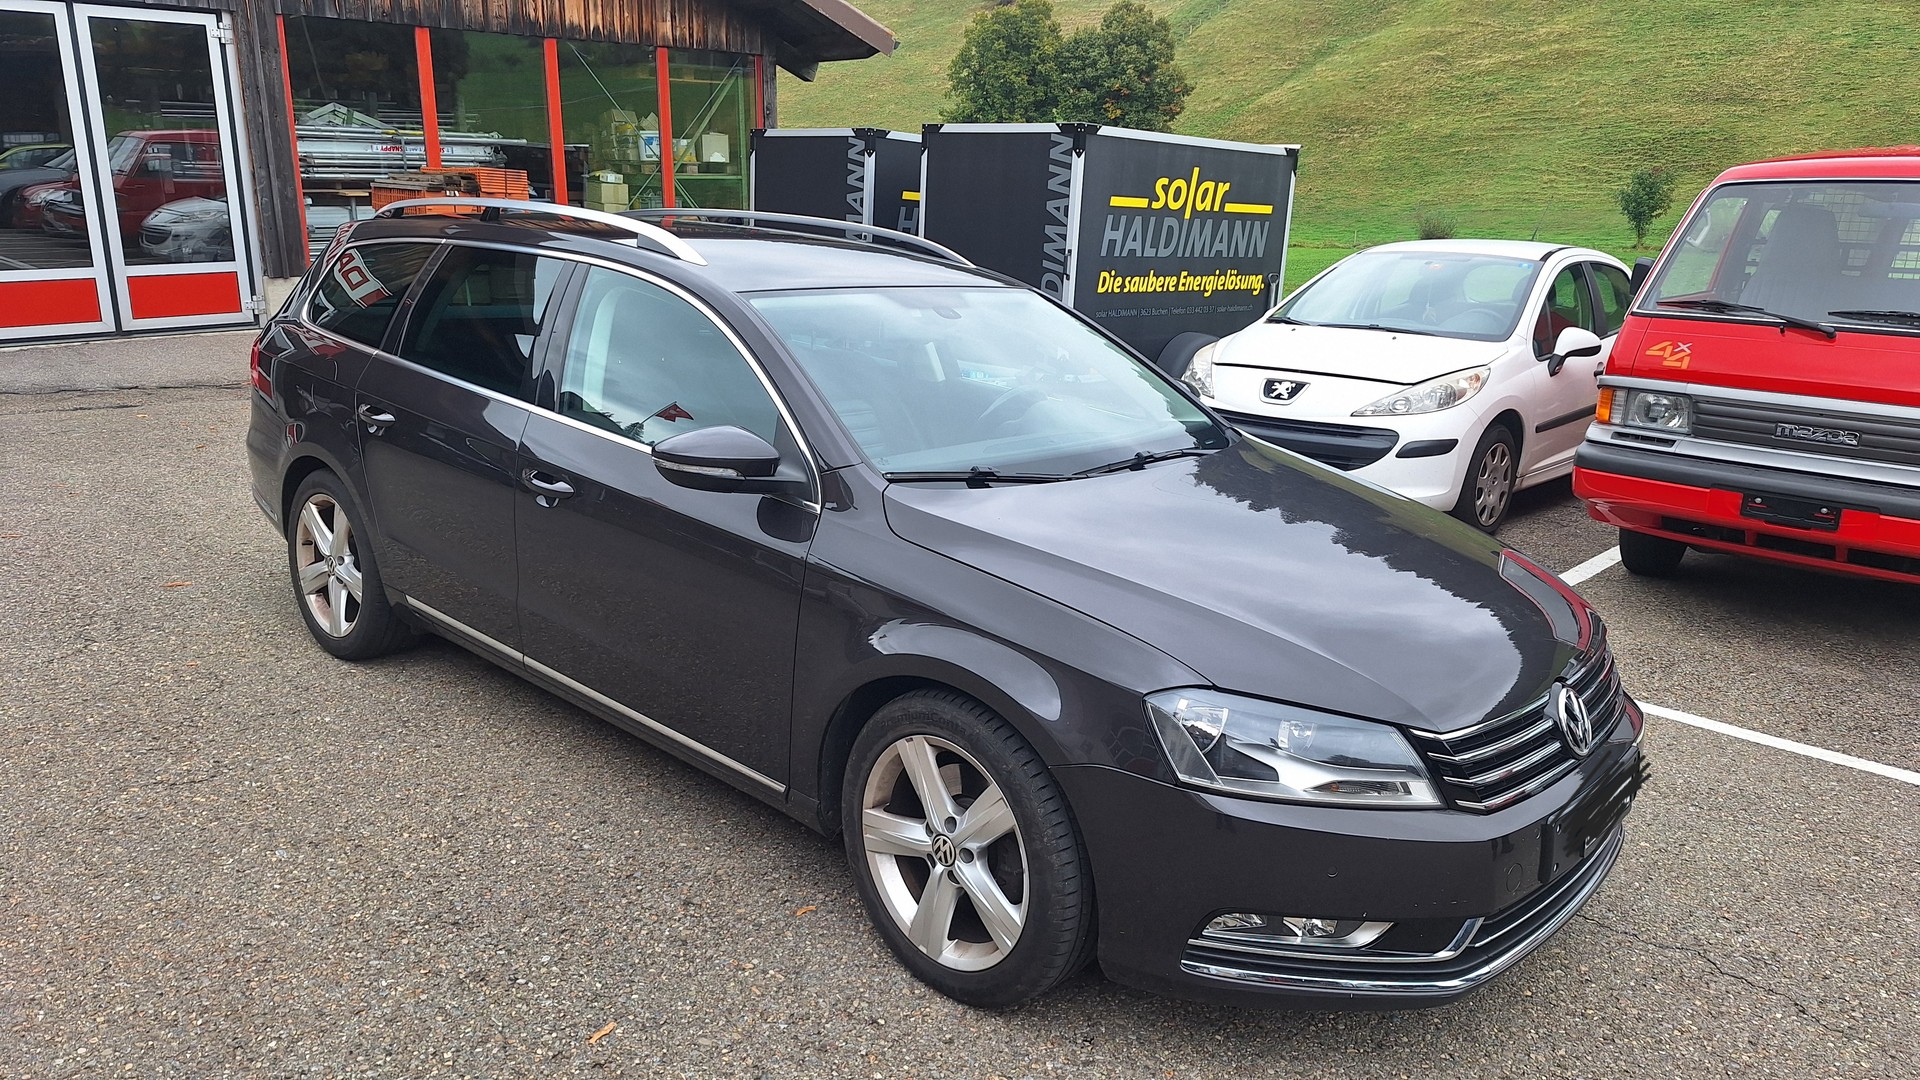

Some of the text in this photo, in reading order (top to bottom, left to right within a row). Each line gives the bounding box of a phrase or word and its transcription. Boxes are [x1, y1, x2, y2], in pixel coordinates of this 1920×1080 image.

[1151, 166, 1231, 219] solar
[1100, 213, 1270, 258] HALDIMANN
[1096, 269, 1265, 297] Die saubere Energielösung.
[1095, 310, 1108, 318] solar
[1108, 308, 1138, 318] HALDIMANN
[1140, 307, 1152, 316] 3623
[1152, 307, 1169, 316] Buchen
[1171, 306, 1186, 315] Telefon
